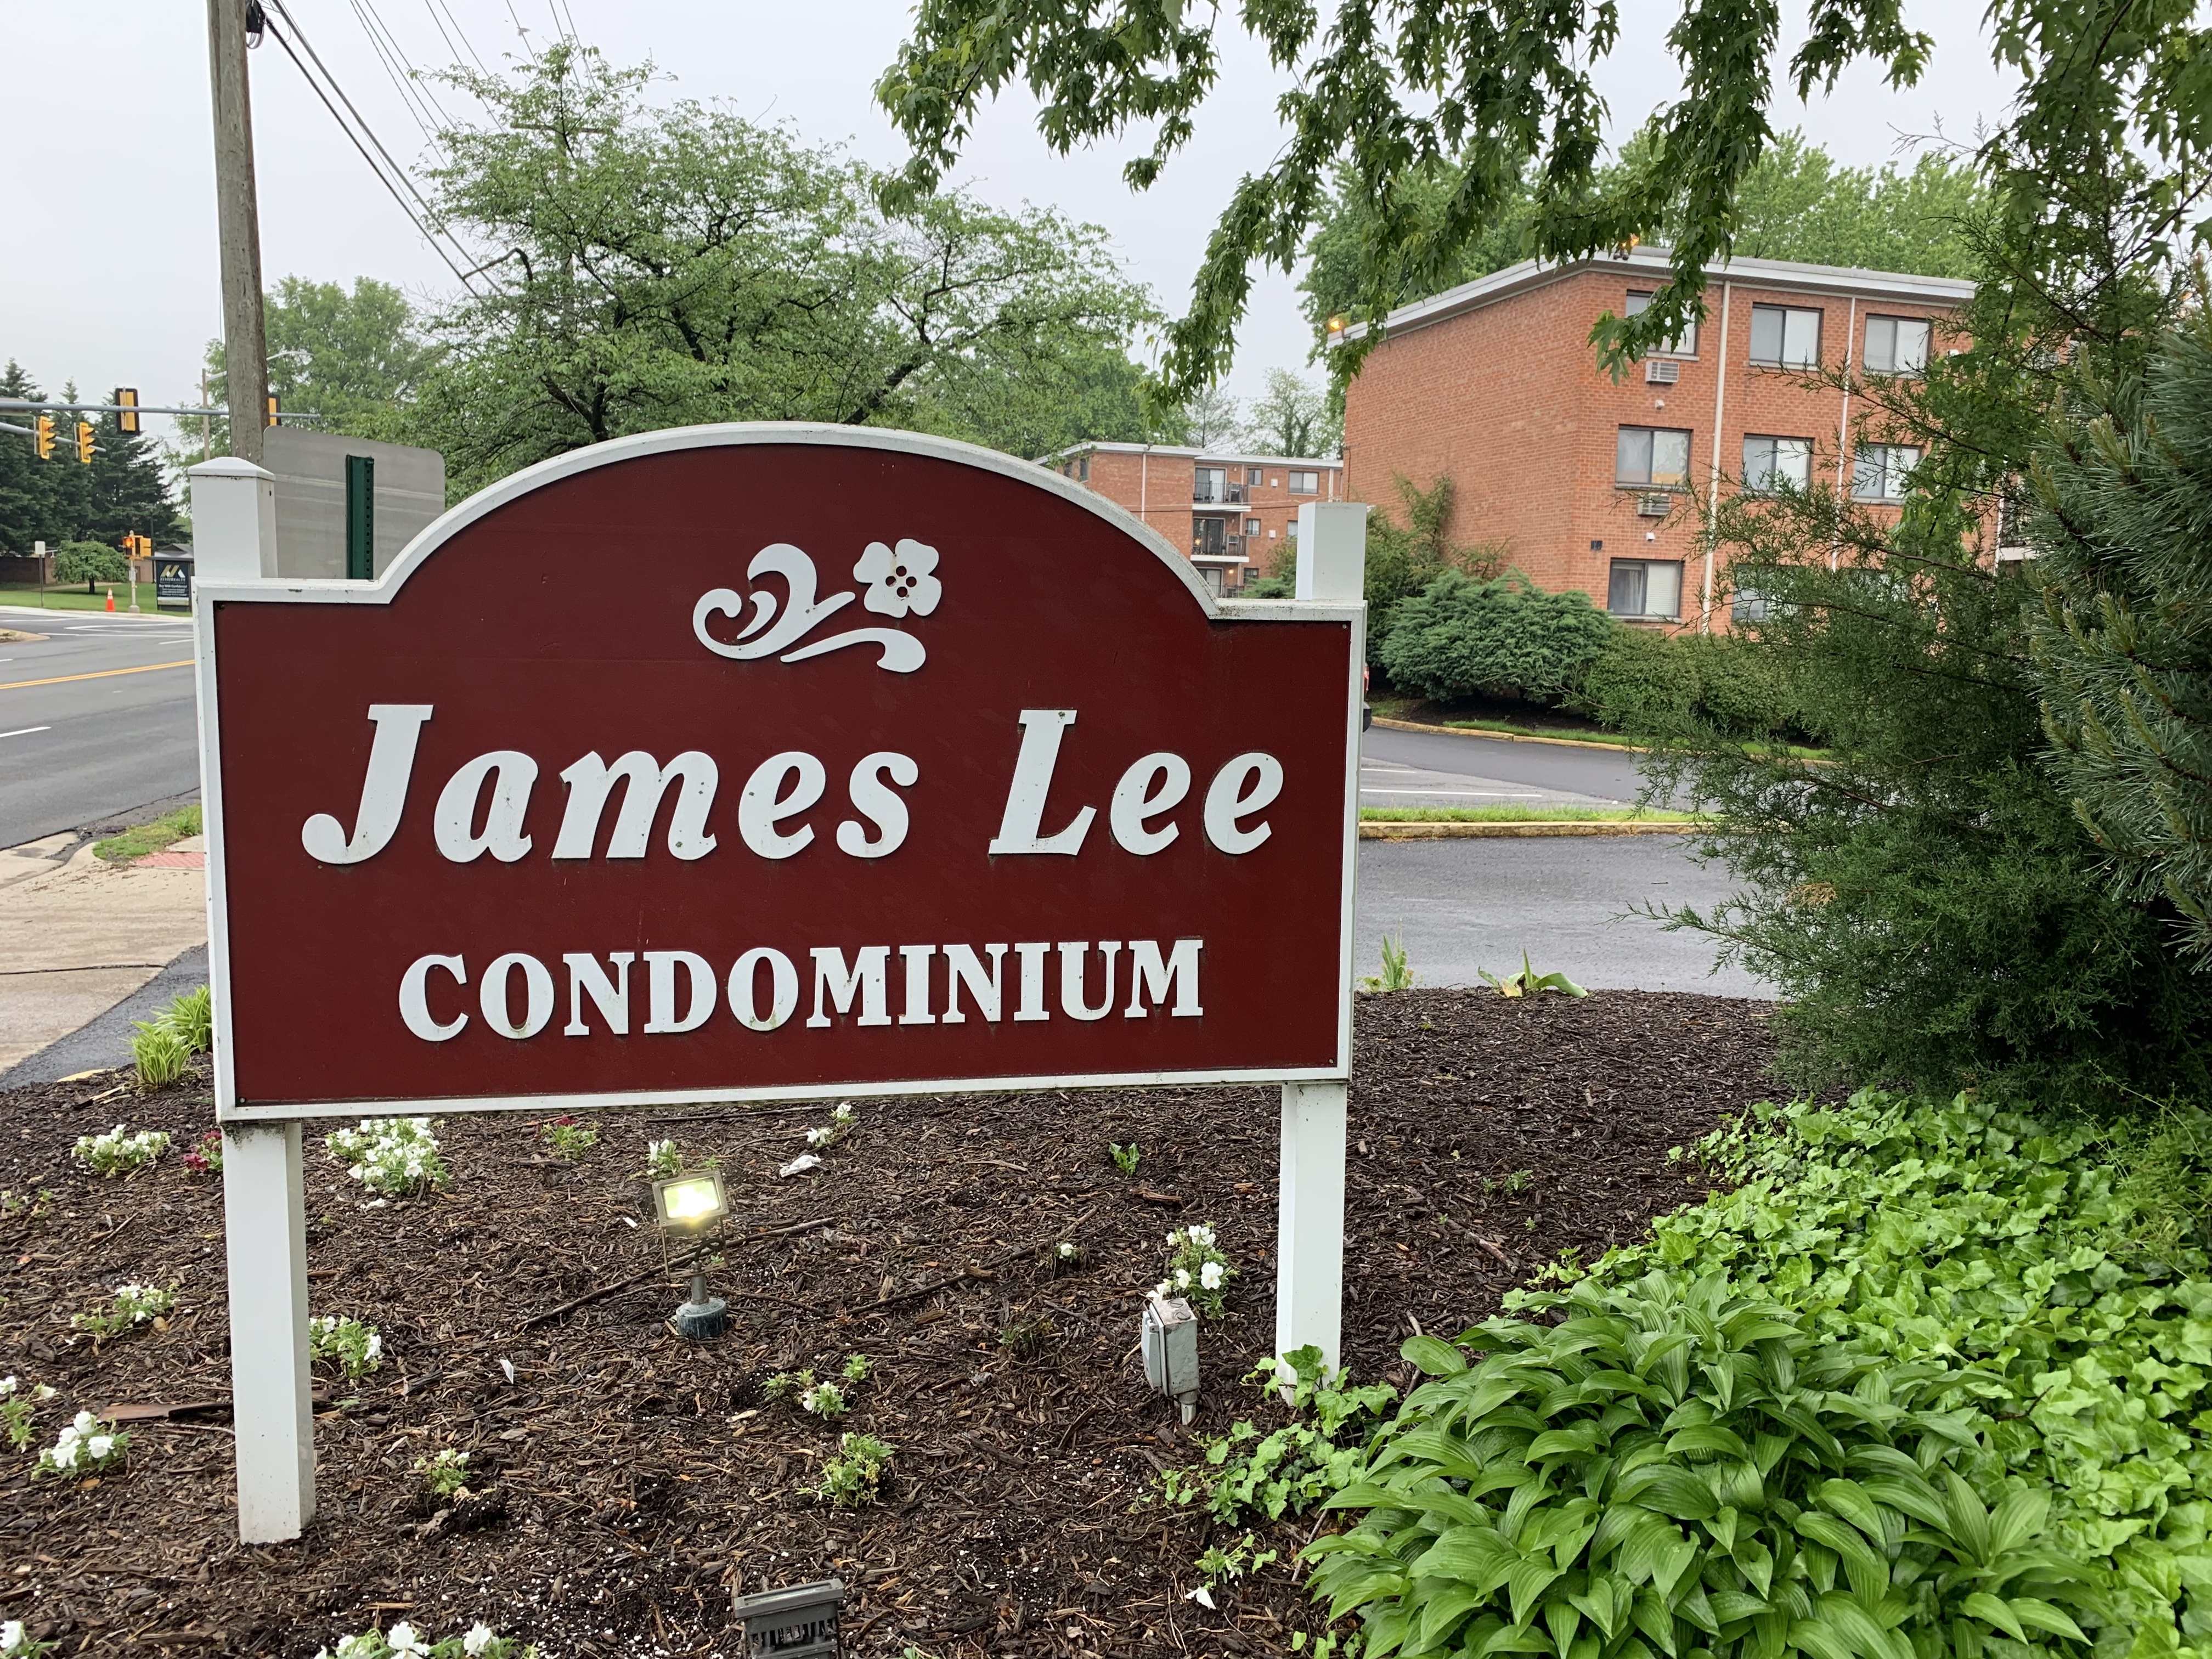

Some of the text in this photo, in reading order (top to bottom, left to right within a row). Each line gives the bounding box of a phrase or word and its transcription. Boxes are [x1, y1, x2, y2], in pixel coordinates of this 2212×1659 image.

[302, 704, 1284, 864] James Lee
[399, 940, 1204, 1041] CONDOMINIUM
